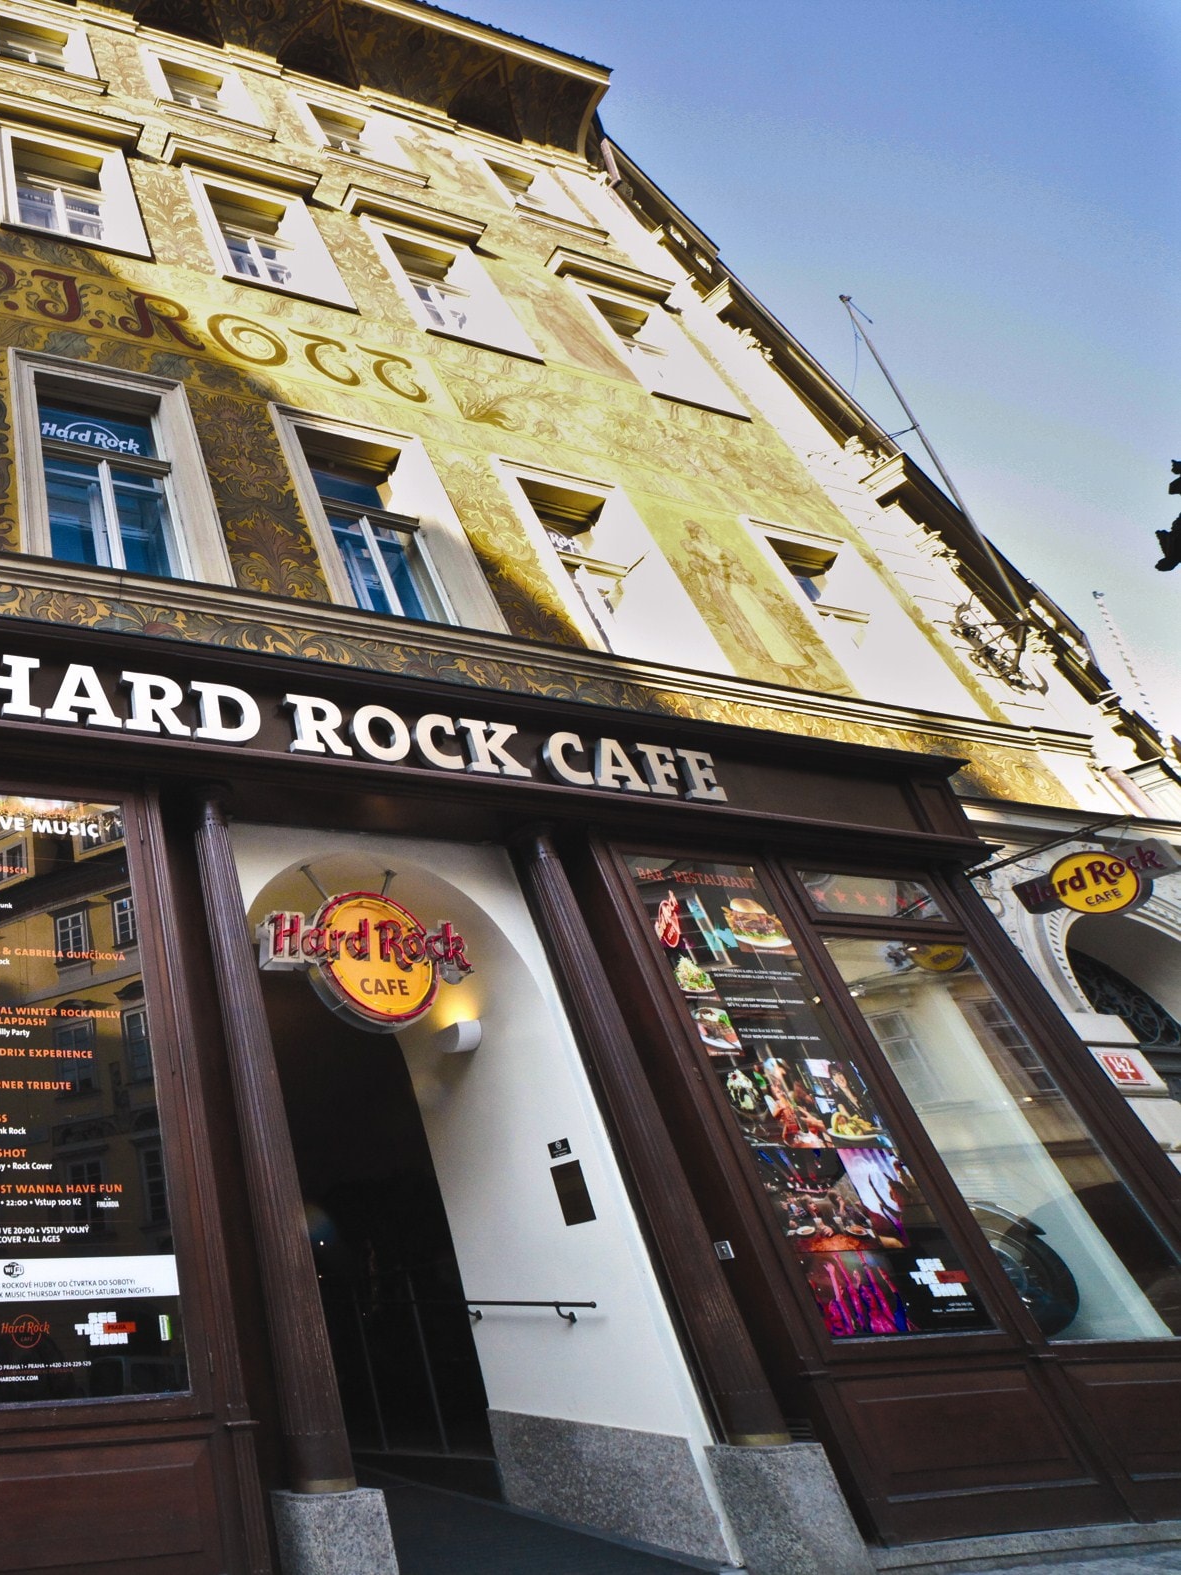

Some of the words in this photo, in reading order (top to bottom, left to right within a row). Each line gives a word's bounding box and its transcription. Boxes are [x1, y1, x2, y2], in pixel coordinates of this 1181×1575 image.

[42, 422, 91, 442] Hard
[94, 432, 140, 455] Rock
[282, 693, 532, 779] ROCK
[541, 730, 729, 802] CAFE
[32, 818, 99, 838] MUSIC
[636, 867, 665, 880] BAR
[672, 871, 756, 889] RESTAURANT
[1020, 867, 1087, 905] Hard
[1085, 846, 1165, 886] Rock
[1085, 888, 1122, 906] CAFE
[271, 912, 370, 961] Hard
[375, 919, 475, 973] Rock
[2, 946, 12, 955] &
[14, 948, 64, 958] GABRIELA
[360, 978, 410, 996] CAFE
[15, 1007, 58, 1017] WINTER
[60, 1009, 121, 1019] ROCKABILLY
[28, 1048, 93, 1059] EXPERIENCE
[1108, 1056, 1135, 1073] 142
[27, 1081, 72, 1090] TRIBUTE
[12, 1162, 30, 1170] Rock
[31, 1162, 53, 1170] Cover
[15, 1184, 63, 1194] WANNA
[66, 1184, 96, 1193] HAVE
[99, 1184, 123, 1193] FUN
[35, 1198, 57, 1208] Vstup
[28, 1235, 40, 1243] ALL
[41, 1235, 61, 1243] AGES
